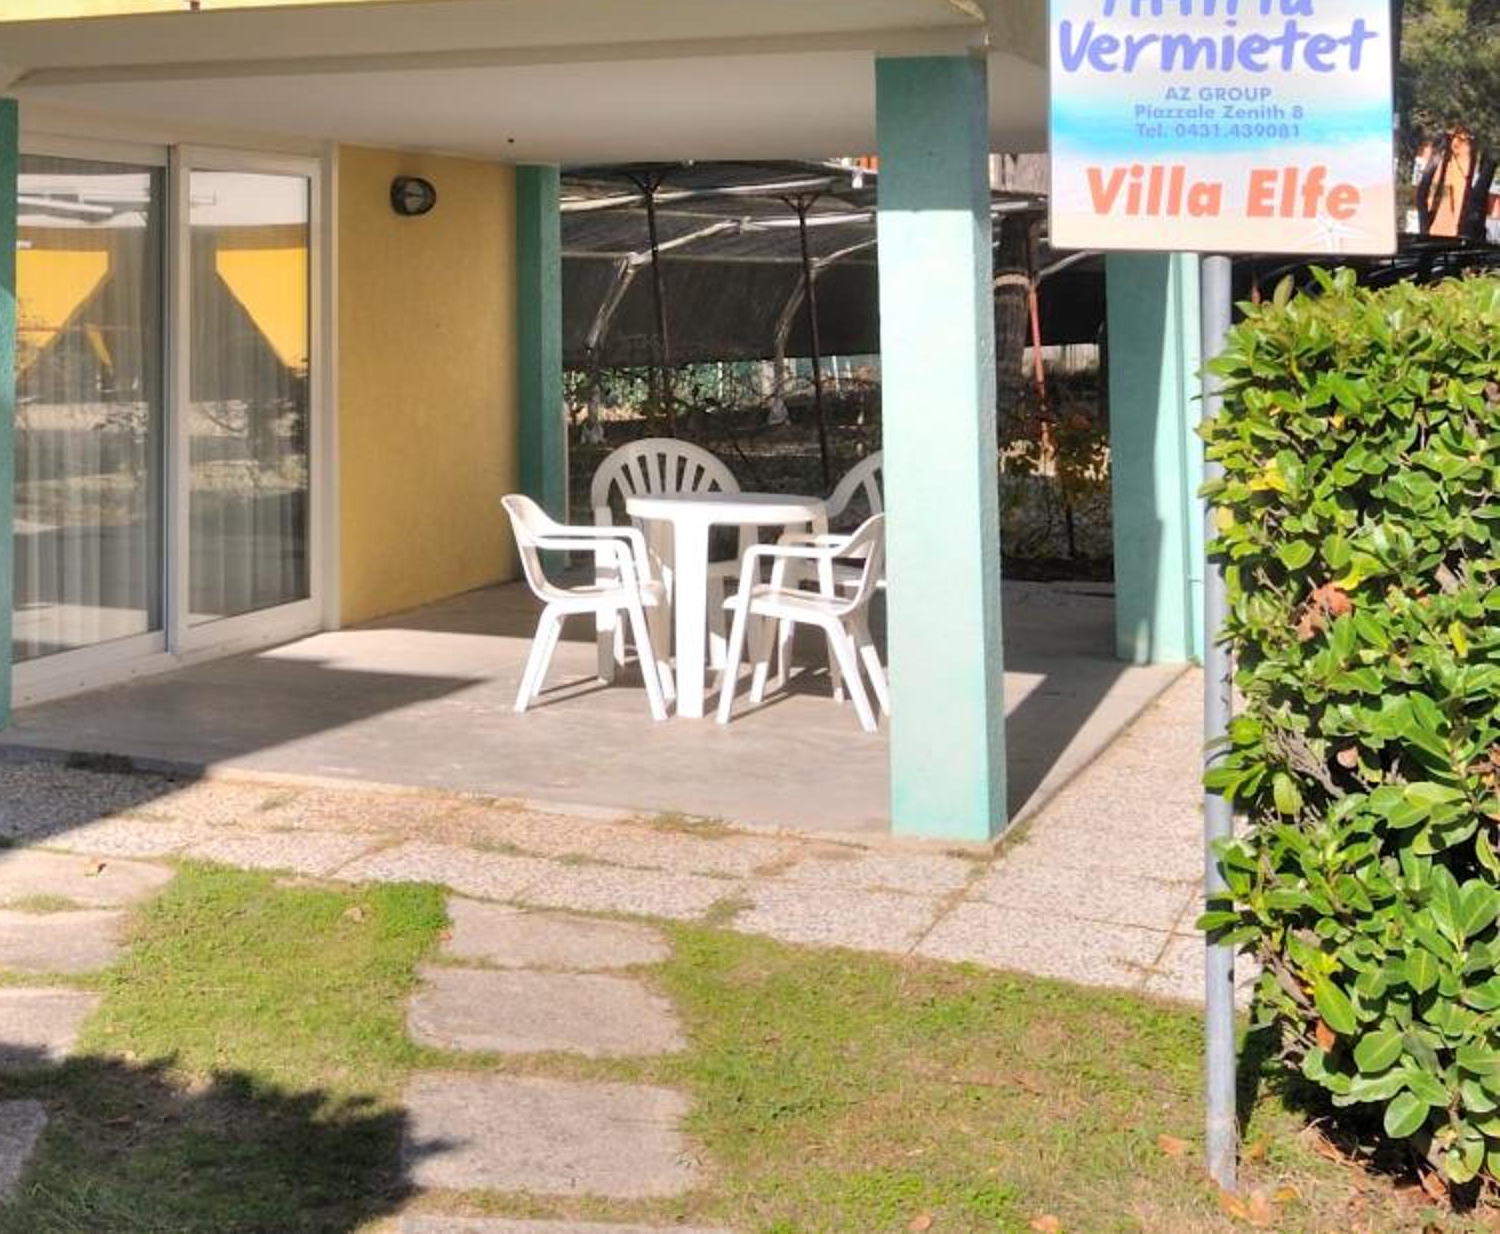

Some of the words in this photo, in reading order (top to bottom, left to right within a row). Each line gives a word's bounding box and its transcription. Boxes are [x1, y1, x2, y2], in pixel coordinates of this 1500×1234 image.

[1058, 18, 1379, 73] Vermietet
[1165, 87, 1191, 101] AZ
[1199, 87, 1272, 102] GROUP
[1134, 104, 1215, 119] Piazzale
[1222, 104, 1285, 119] Zenith
[1292, 106, 1304, 119] 8
[1136, 123, 1168, 138] Tel.
[1175, 123, 1300, 138] 0431.439081
[1086, 163, 1223, 216] Villa
[1246, 166, 1361, 220] Elfe
